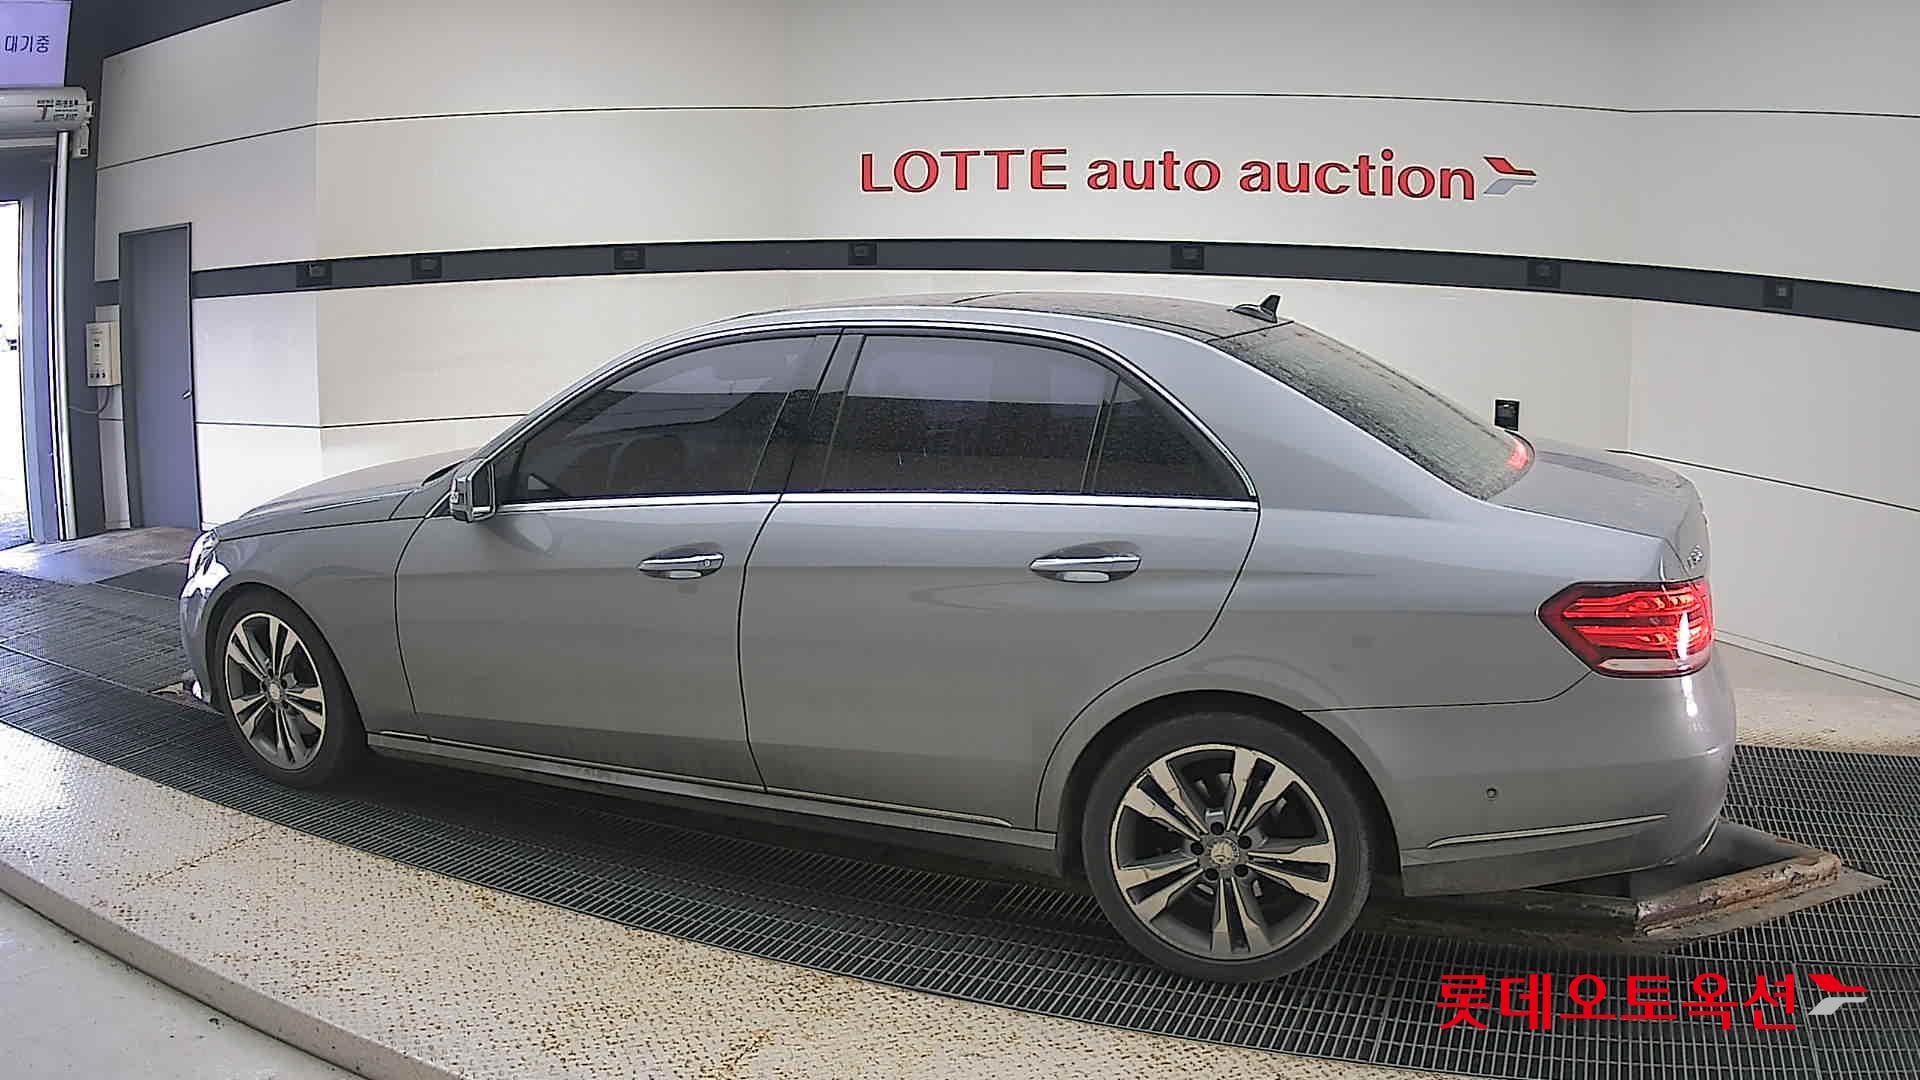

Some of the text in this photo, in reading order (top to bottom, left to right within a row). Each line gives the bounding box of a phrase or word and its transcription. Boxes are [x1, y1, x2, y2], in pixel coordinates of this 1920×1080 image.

[5, 35, 49, 53] 대기중
[861, 148, 1475, 200] LOTTE auto auction
